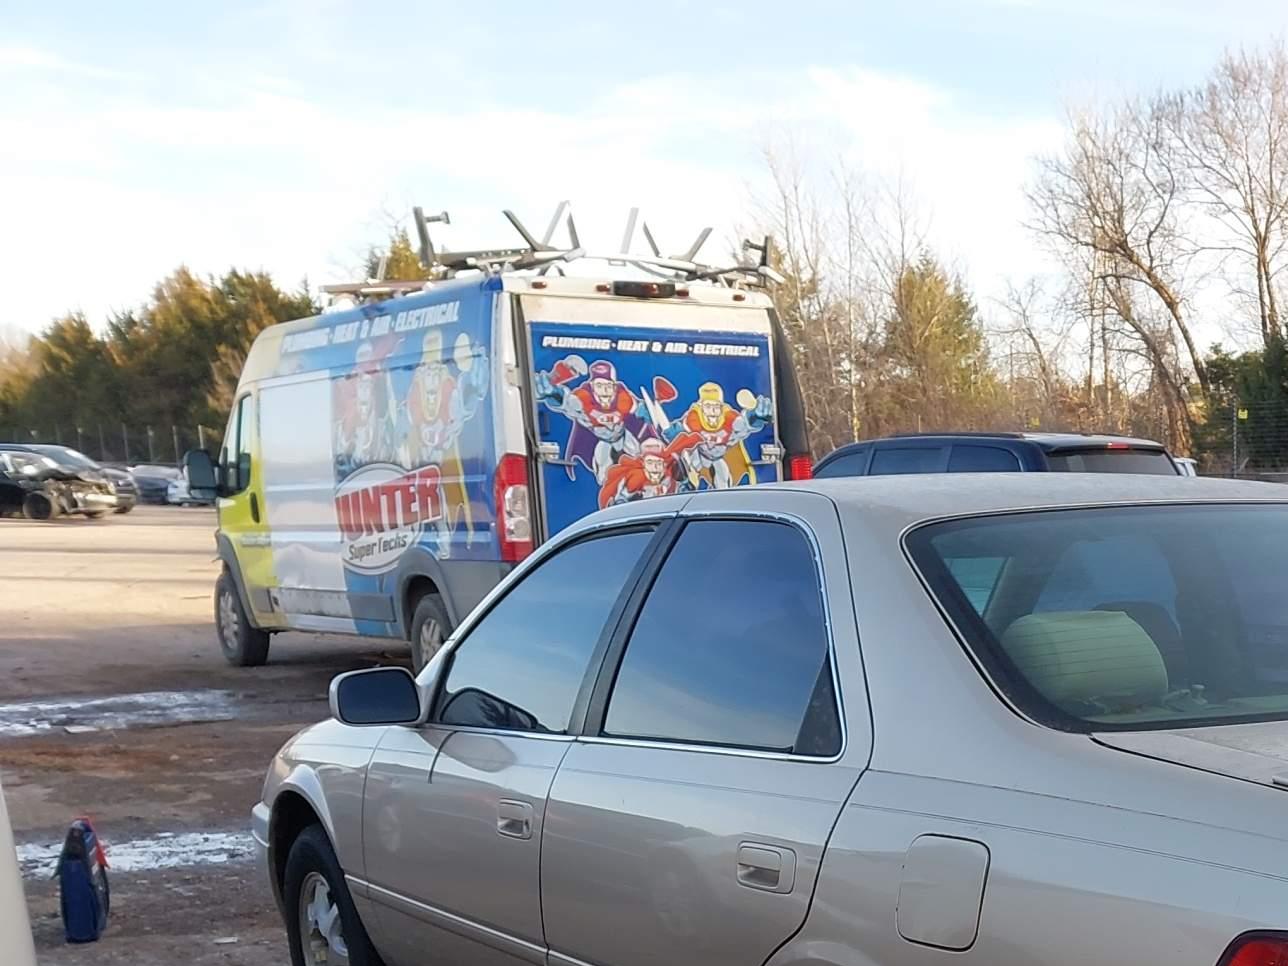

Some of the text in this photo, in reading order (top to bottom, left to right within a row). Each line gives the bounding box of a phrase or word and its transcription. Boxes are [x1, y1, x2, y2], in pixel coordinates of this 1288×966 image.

[333, 321, 360, 344] HEAT
[370, 315, 392, 337] AIR
[395, 301, 461, 332] ELECTRICAL
[542, 336, 760, 357] PLUMBING HEAT & AIR ELECTRICAL
